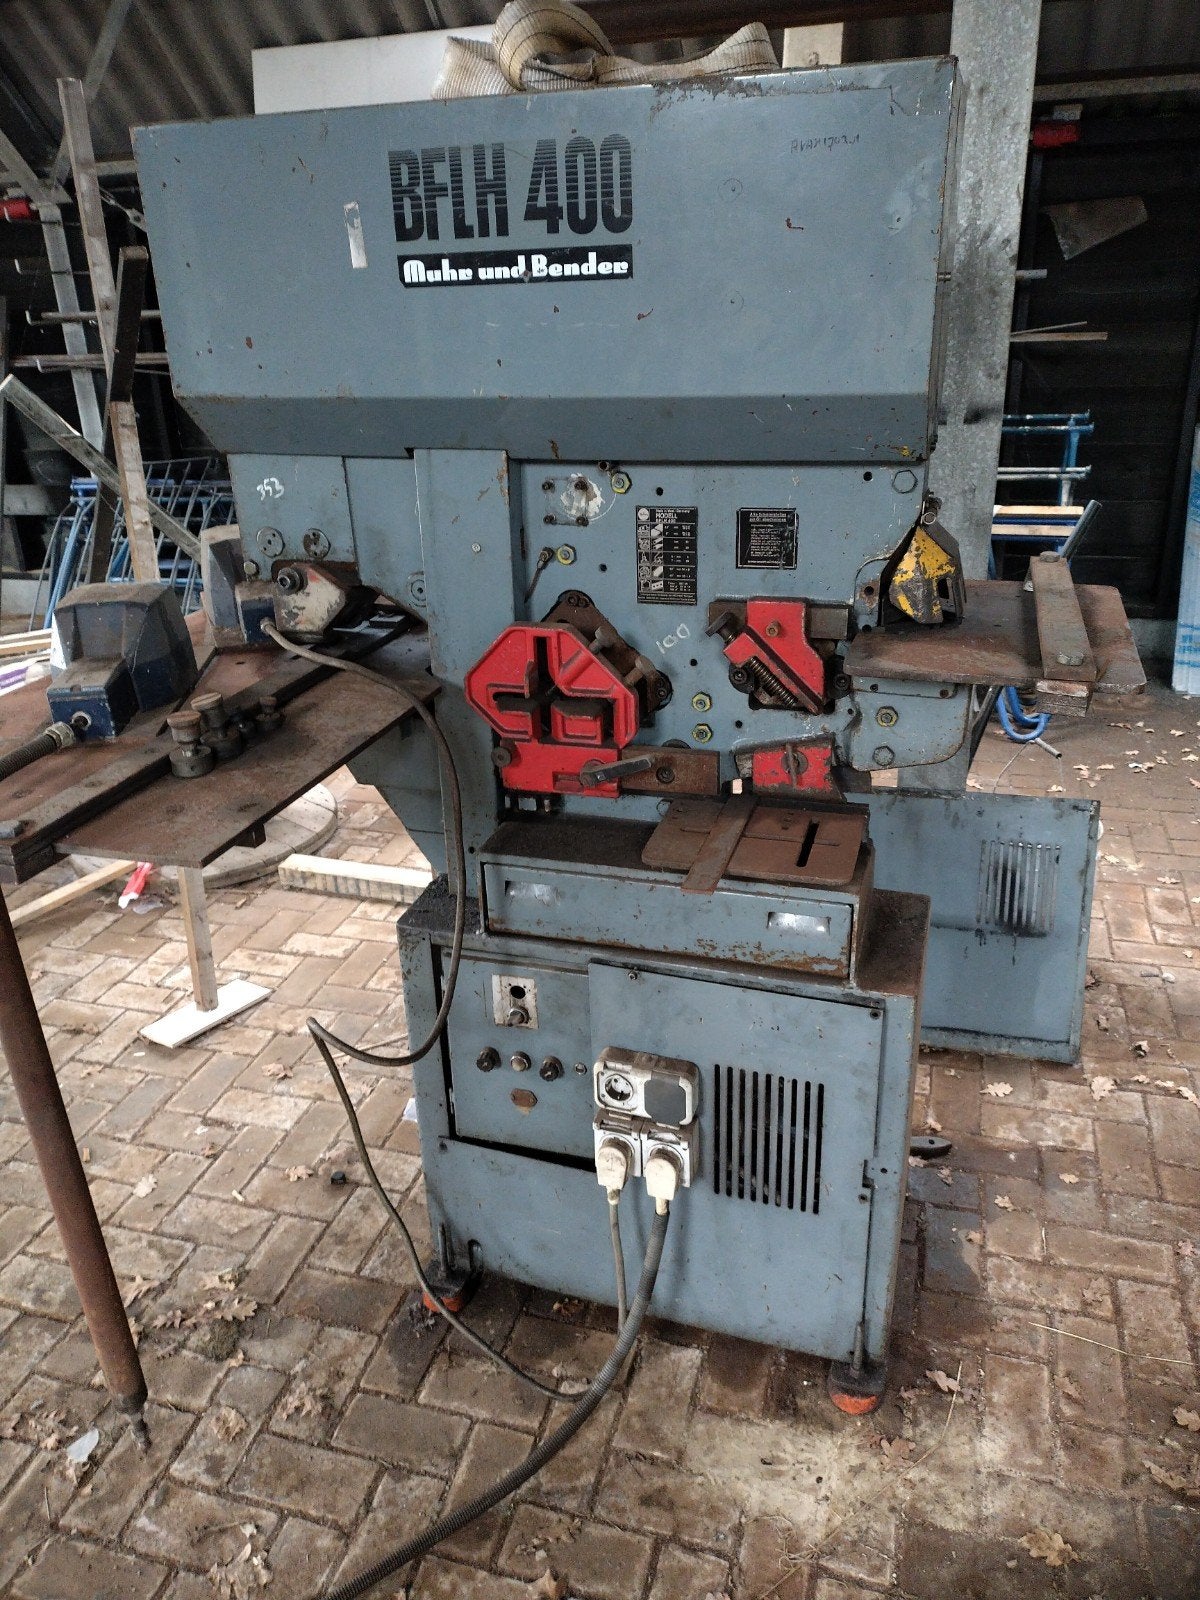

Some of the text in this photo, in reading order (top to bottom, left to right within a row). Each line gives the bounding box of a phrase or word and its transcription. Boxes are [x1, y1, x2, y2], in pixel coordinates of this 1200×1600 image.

[388, 134, 633, 242] BFLH 400
[403, 252, 629, 283] Muhr und Bender
